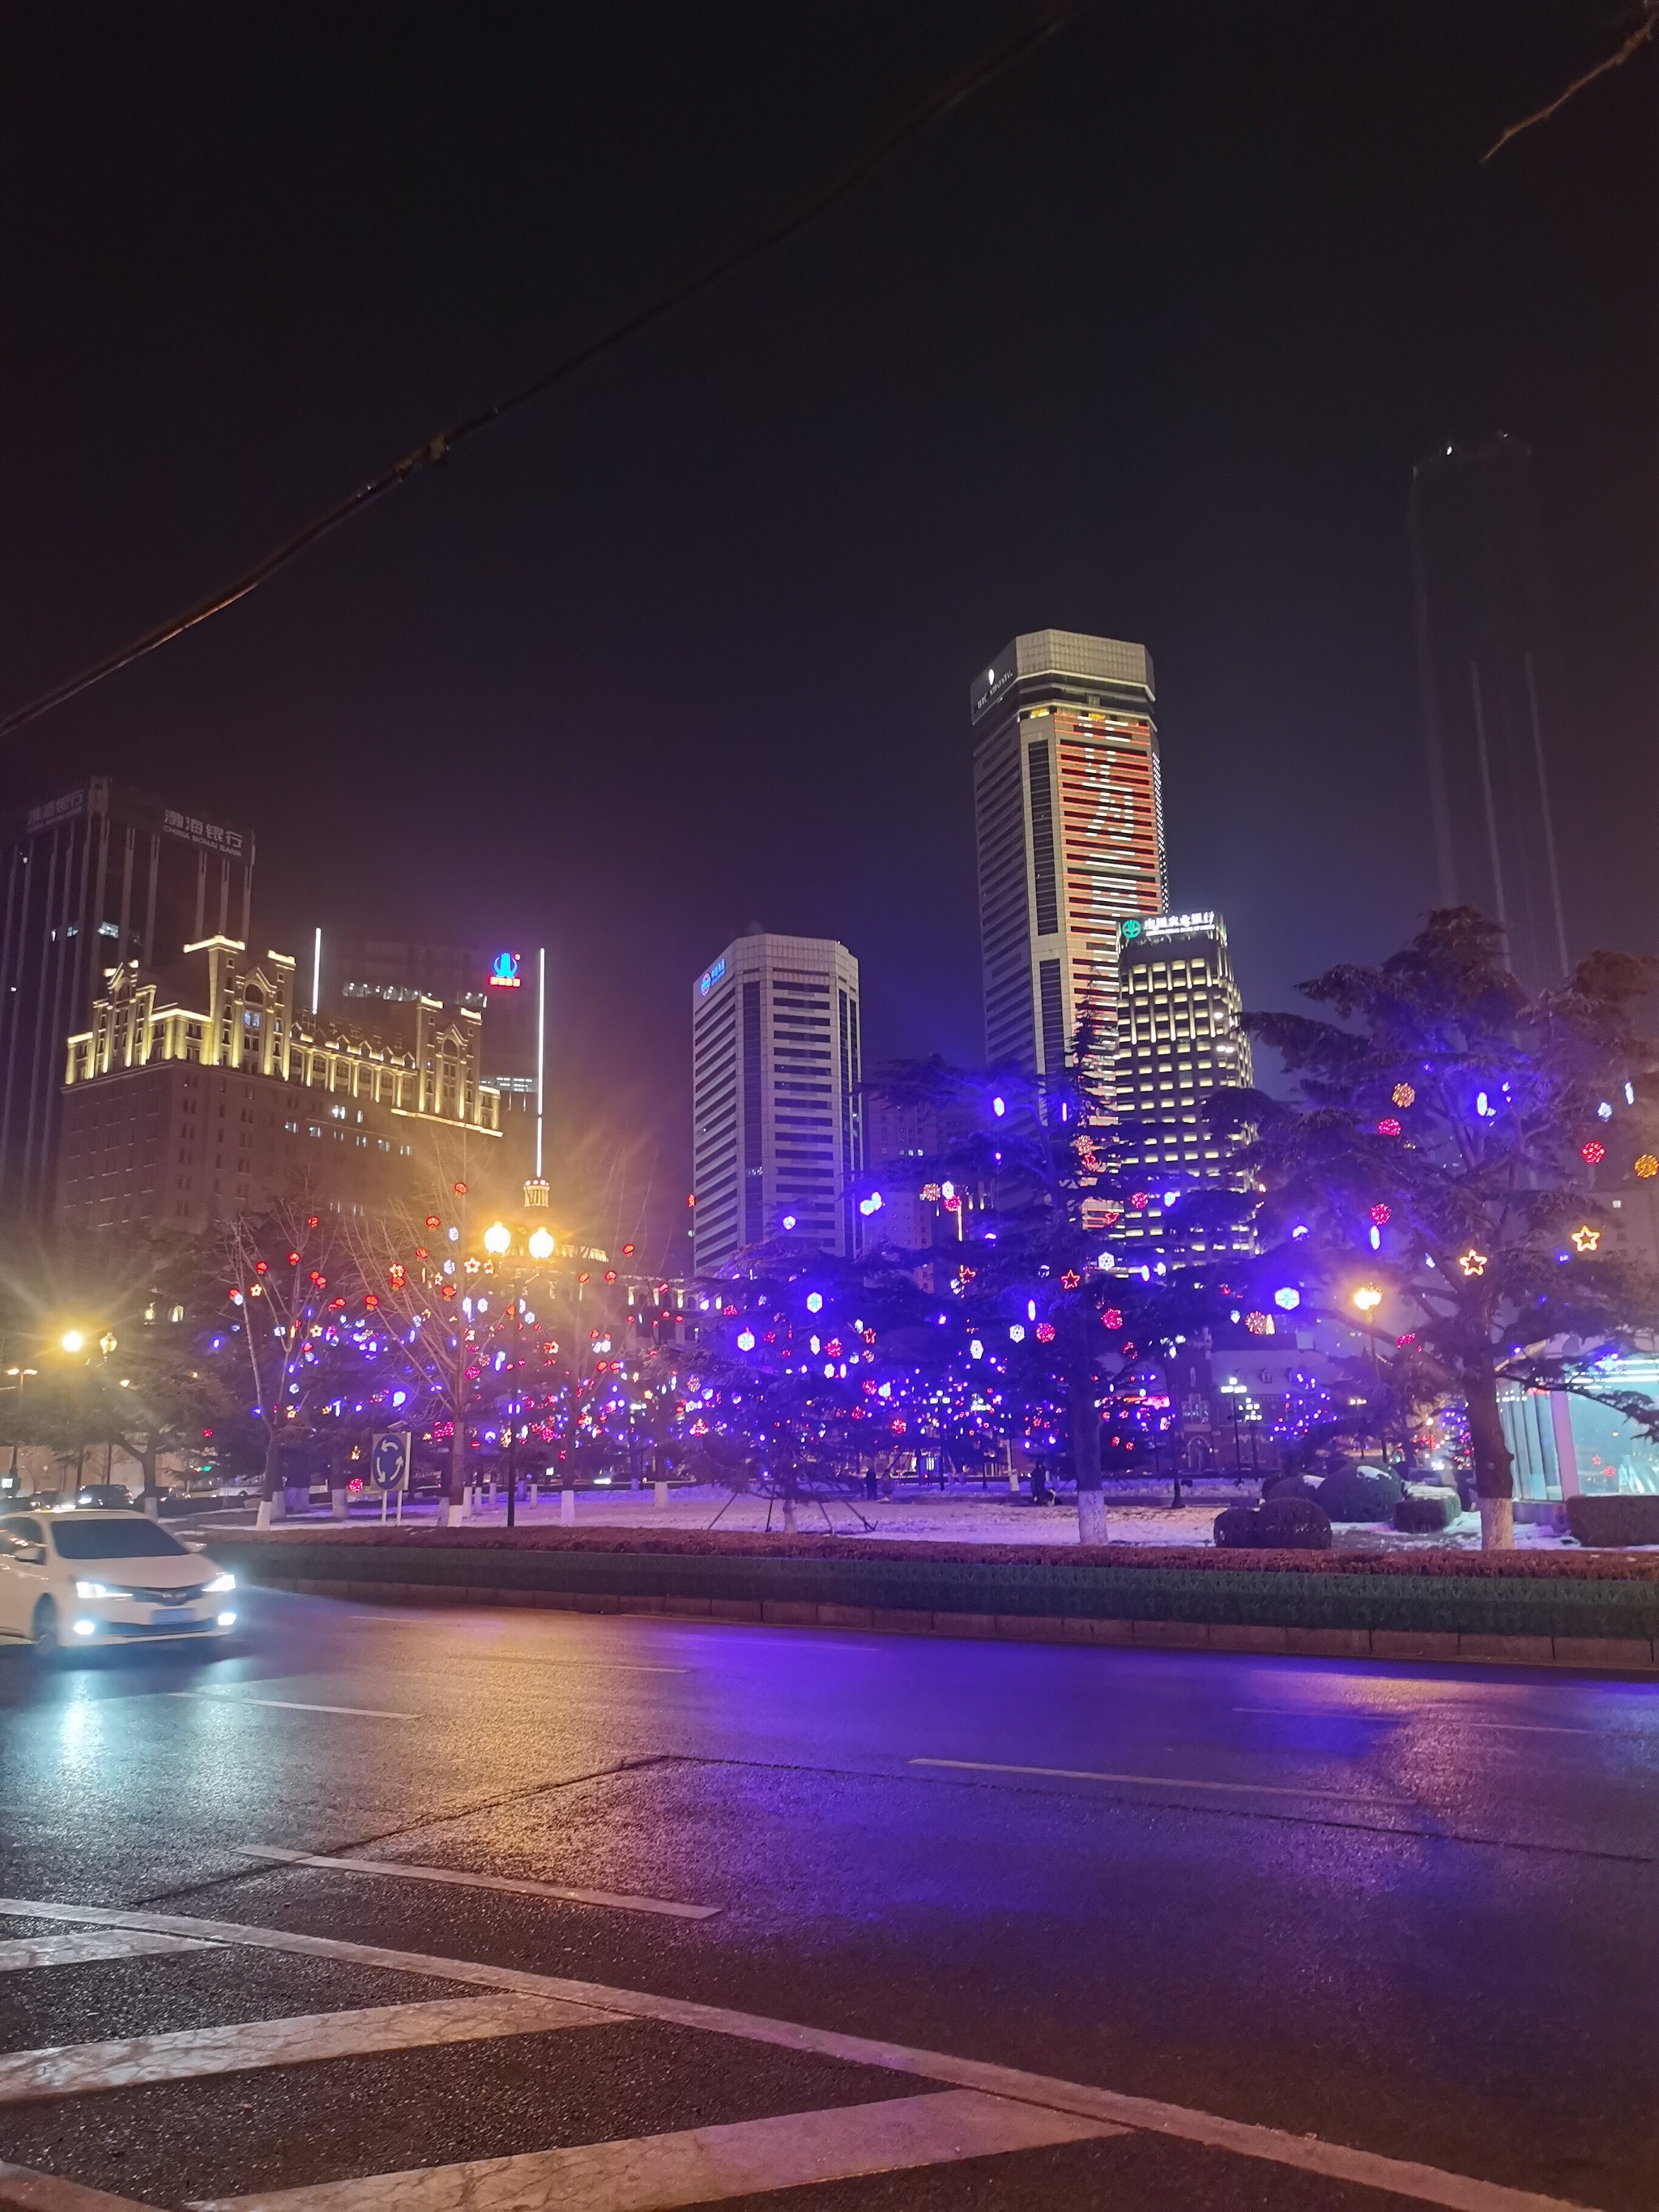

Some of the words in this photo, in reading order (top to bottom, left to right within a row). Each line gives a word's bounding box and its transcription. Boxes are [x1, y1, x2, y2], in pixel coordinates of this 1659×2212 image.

[164, 809, 243, 849] 渤海银行
[164, 826, 190, 839] CHINA
[220, 844, 242, 857] BANK
[1144, 911, 1214, 931] 中国农业银行
